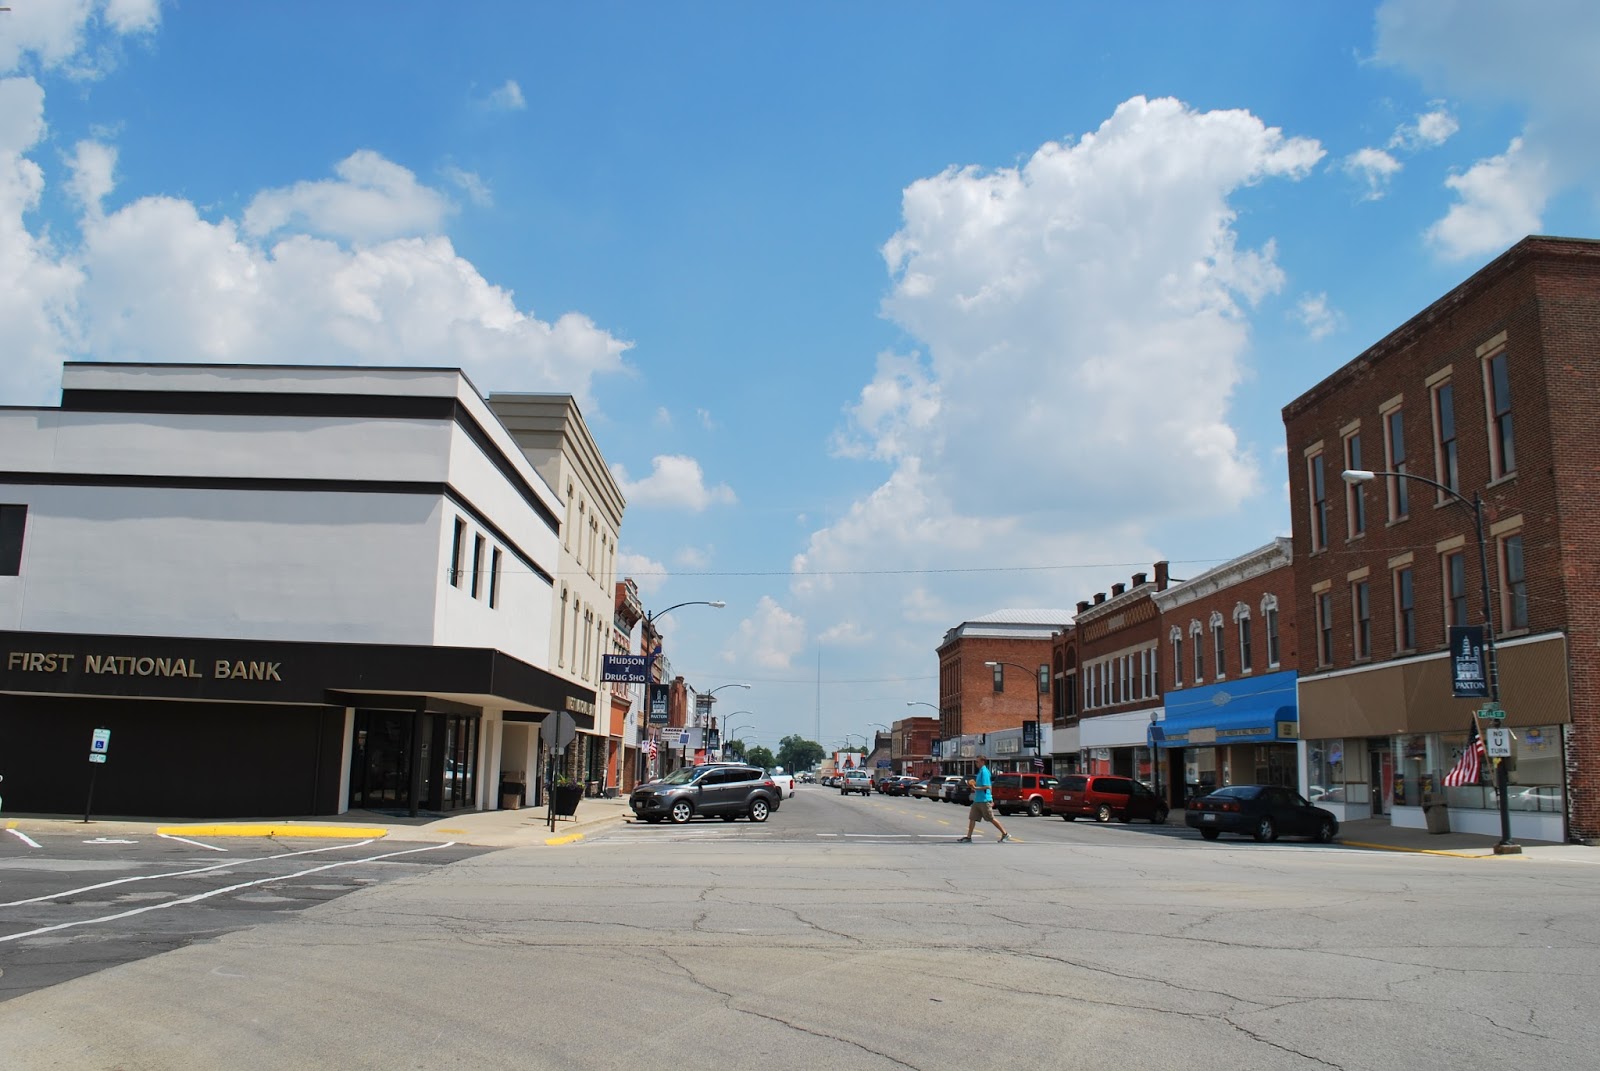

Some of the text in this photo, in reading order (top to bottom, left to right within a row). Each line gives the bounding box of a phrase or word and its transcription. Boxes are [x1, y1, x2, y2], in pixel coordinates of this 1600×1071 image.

[609, 656, 644, 665] HUDSON
[7, 652, 283, 682] FIRST NATIONAL BANK
[605, 672, 627, 681] DRUG
